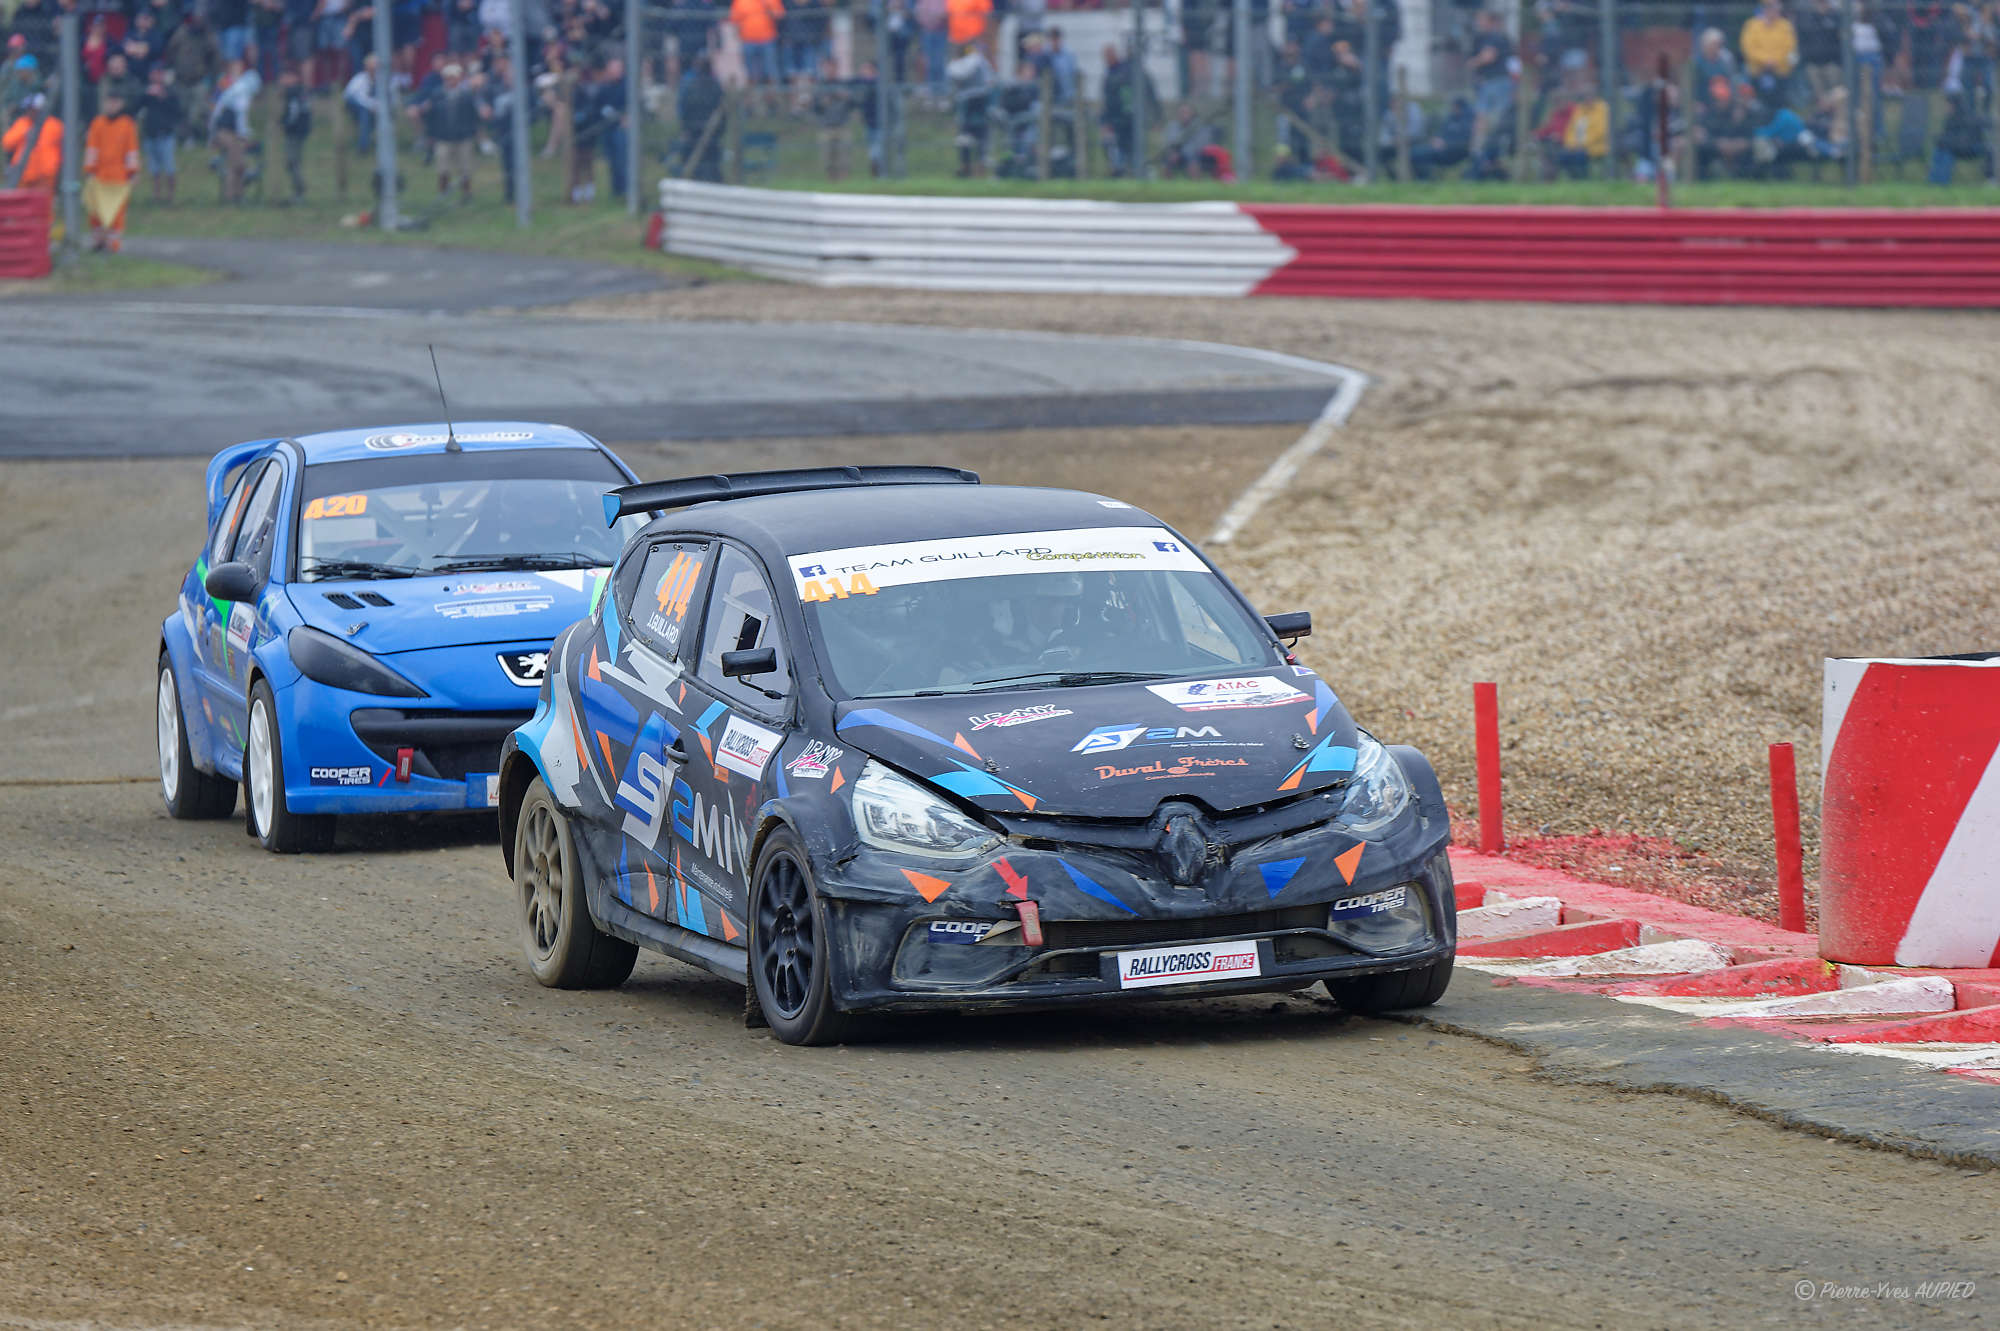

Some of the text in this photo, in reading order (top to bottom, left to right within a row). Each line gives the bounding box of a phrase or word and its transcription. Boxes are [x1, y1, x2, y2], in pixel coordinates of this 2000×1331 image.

[303, 494, 368, 521] 420
[835, 547, 1052, 574] TEAM GUILLARD
[657, 551, 703, 623] 414
[803, 572, 880, 603] 414
[1215, 680, 1257, 691] ATAC
[311, 767, 370, 778] COOPER
[337, 777, 370, 785] TIRES
[1094, 765, 1165, 785] Duval
[1334, 886, 1407, 911] COOPER
[1370, 897, 1406, 912] TIRES
[1129, 951, 1255, 977] RALLYCROSS FRANCE
